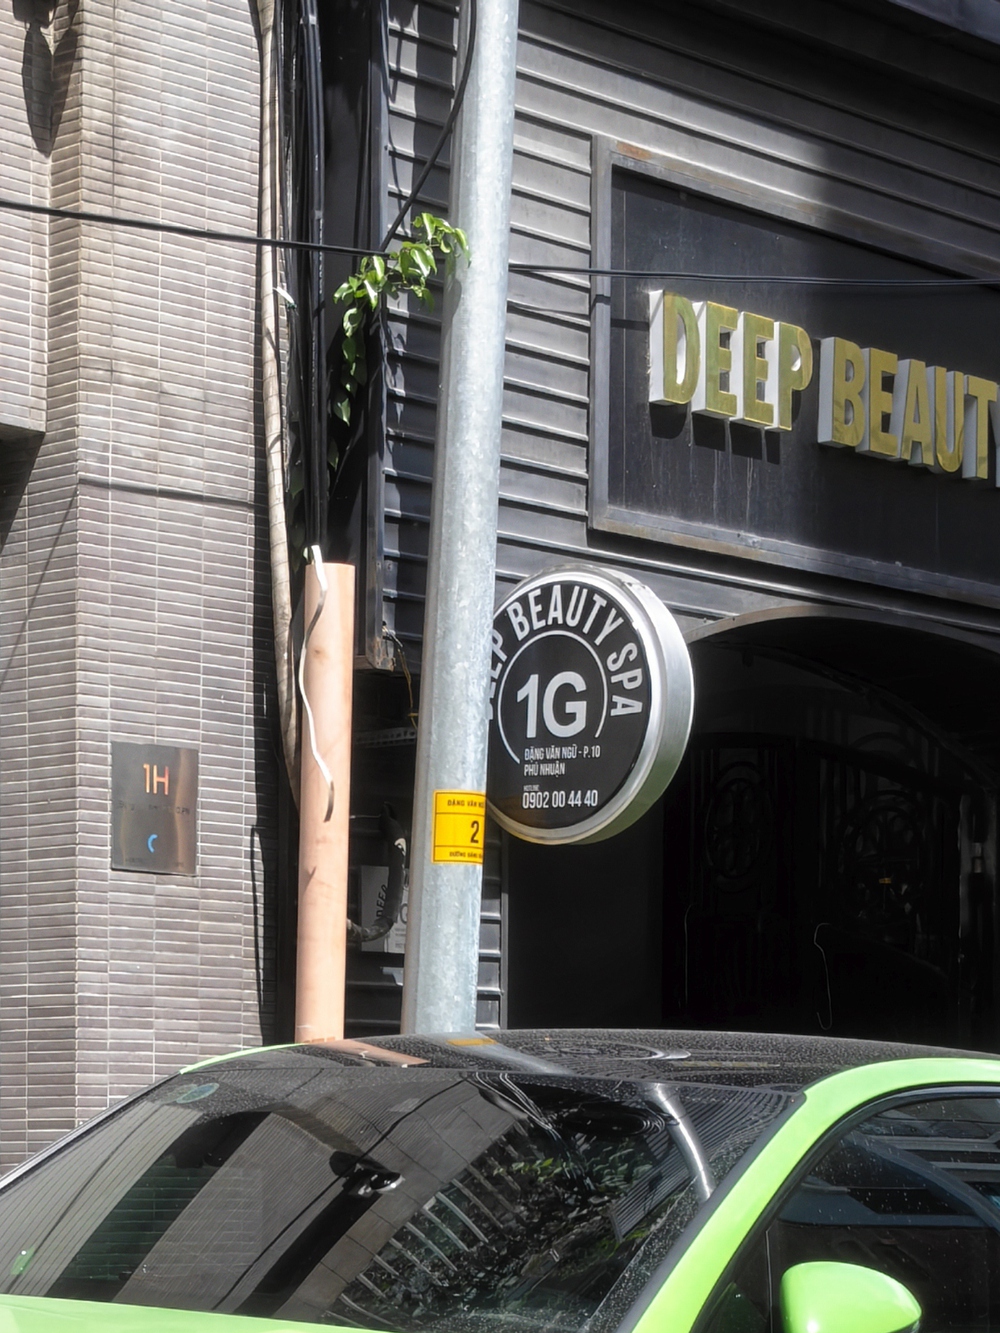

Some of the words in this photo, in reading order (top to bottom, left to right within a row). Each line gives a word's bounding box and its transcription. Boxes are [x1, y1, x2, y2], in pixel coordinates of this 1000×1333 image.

[649, 289, 813, 431] DEEP
[818, 336, 1000, 488] BEAUT
[506, 584, 625, 645] BEAUTY
[606, 642, 643, 717] SPA
[517, 670, 587, 738] 1G
[143, 763, 170, 796] 1H
[522, 791, 549, 809] 0902
[551, 790, 566, 808] 00
[567, 790, 582, 807] 44
[584, 789, 598, 807] 40
[470, 820, 480, 844] 2
